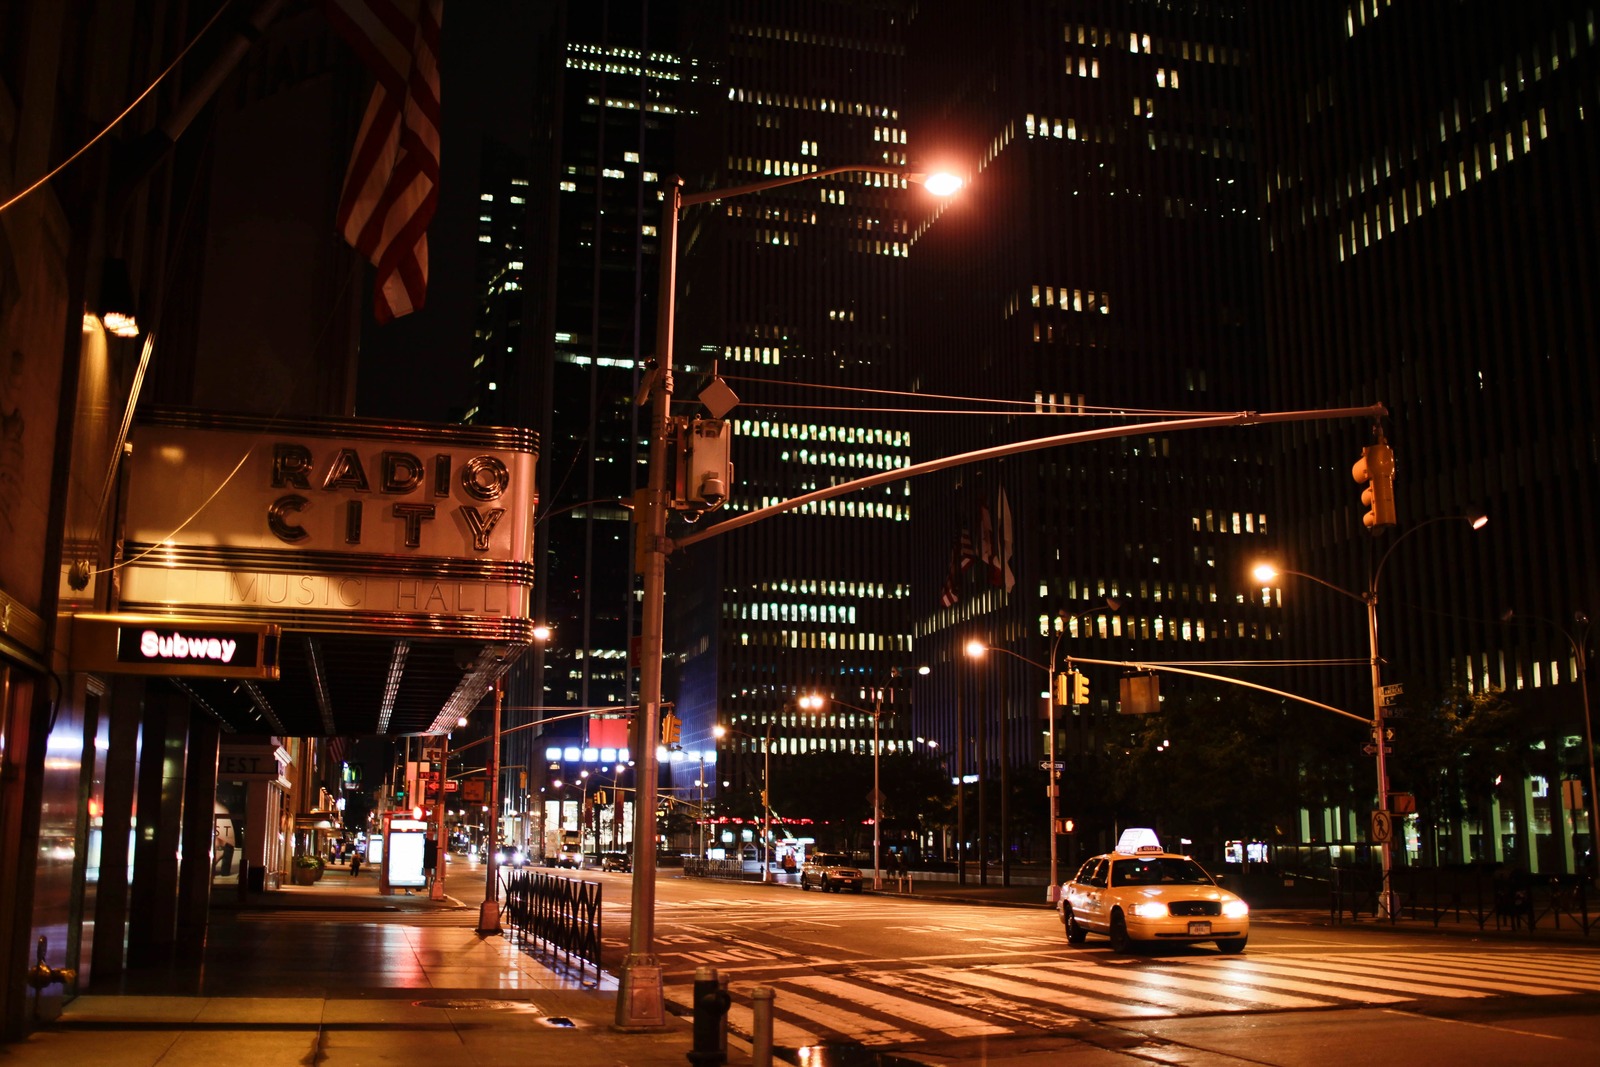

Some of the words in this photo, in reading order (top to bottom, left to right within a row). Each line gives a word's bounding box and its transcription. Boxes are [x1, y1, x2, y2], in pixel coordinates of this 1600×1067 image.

[270, 441, 510, 501] RADIO
[267, 494, 506, 551] CITY
[228, 571, 362, 608] MUSIC
[397, 579, 502, 613] HALL
[140, 630, 237, 663] Subway
[221, 757, 261, 773] EST
[215, 826, 232, 837] ST
[658, 946, 778, 965] ONL
